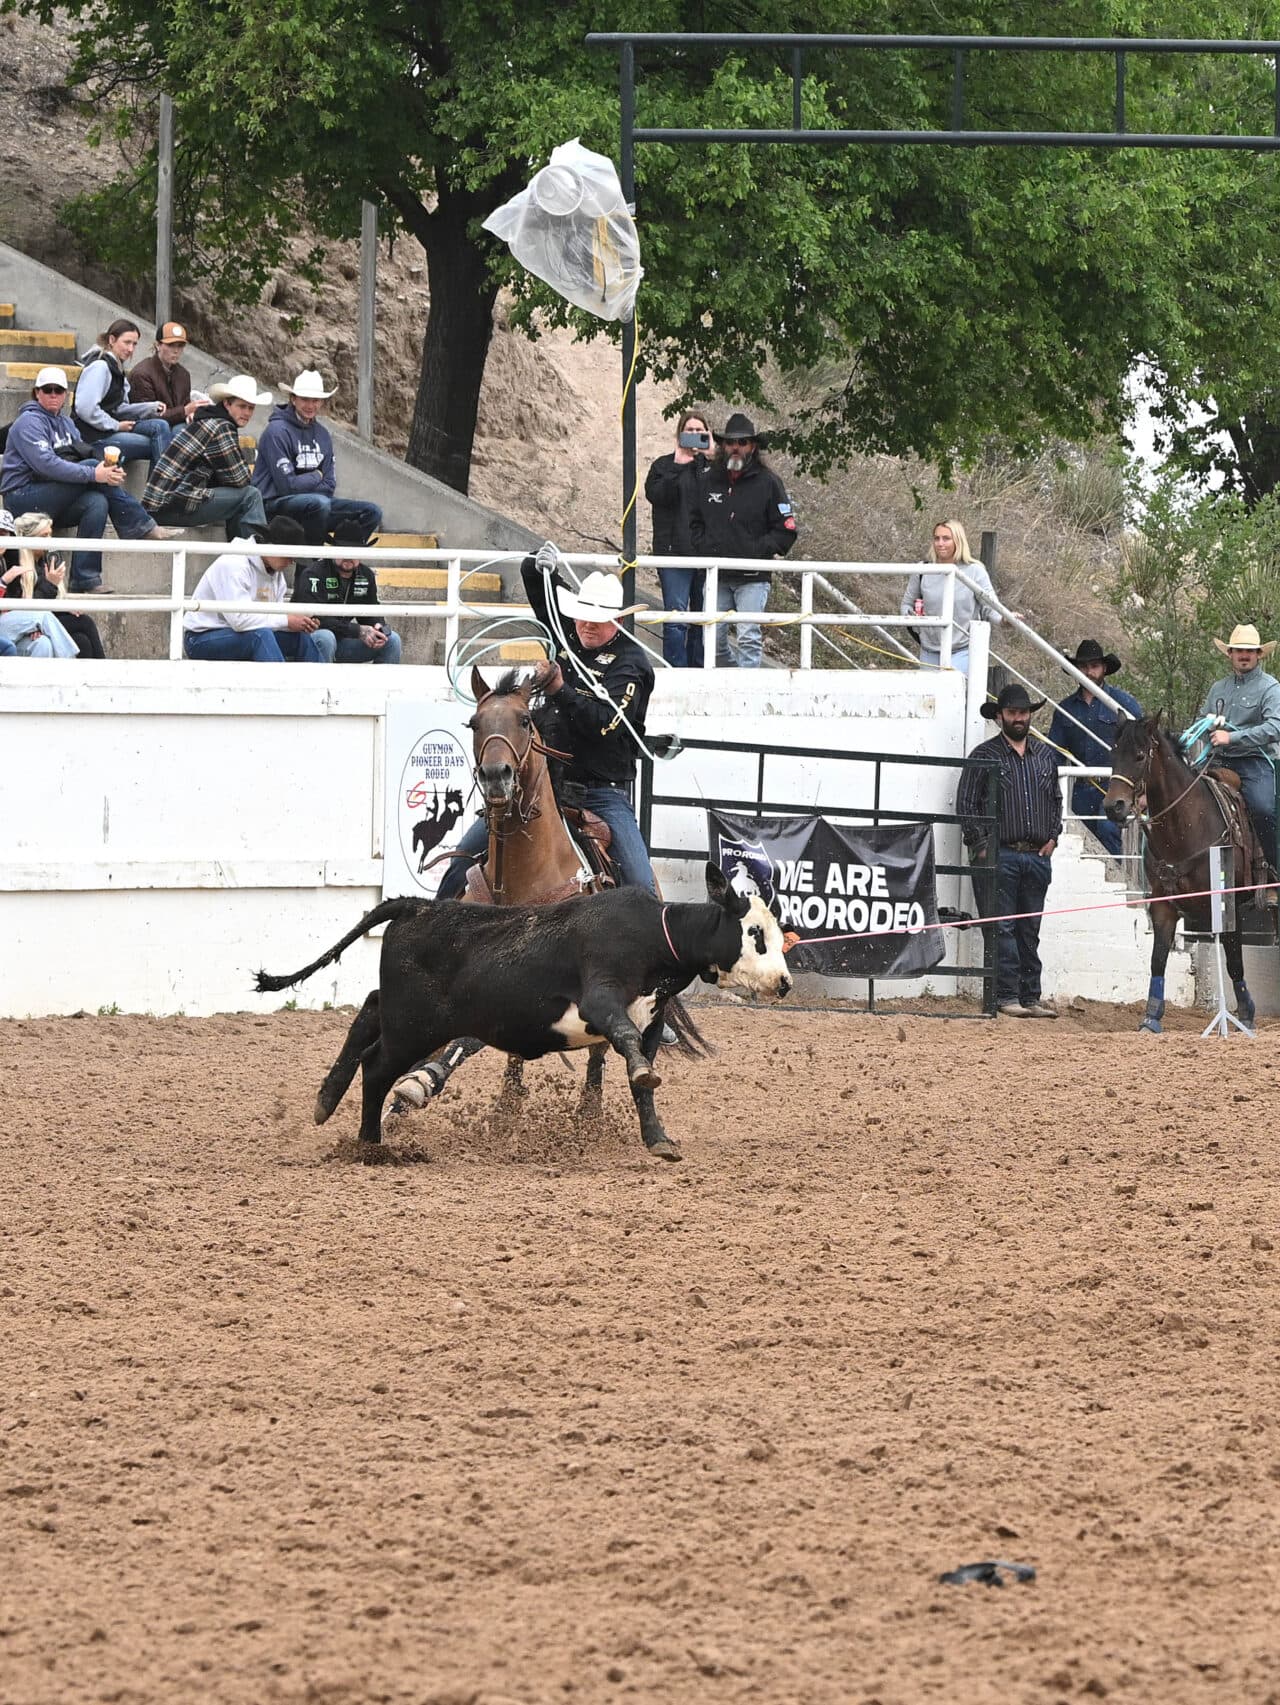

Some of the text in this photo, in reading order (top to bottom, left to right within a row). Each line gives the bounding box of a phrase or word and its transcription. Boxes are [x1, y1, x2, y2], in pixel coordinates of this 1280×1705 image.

[422, 743, 454, 755] GUYMON
[411, 755, 465, 767] PIONEER DAYS
[425, 768, 450, 780] RODEO
[775, 859, 890, 898] WE ARE
